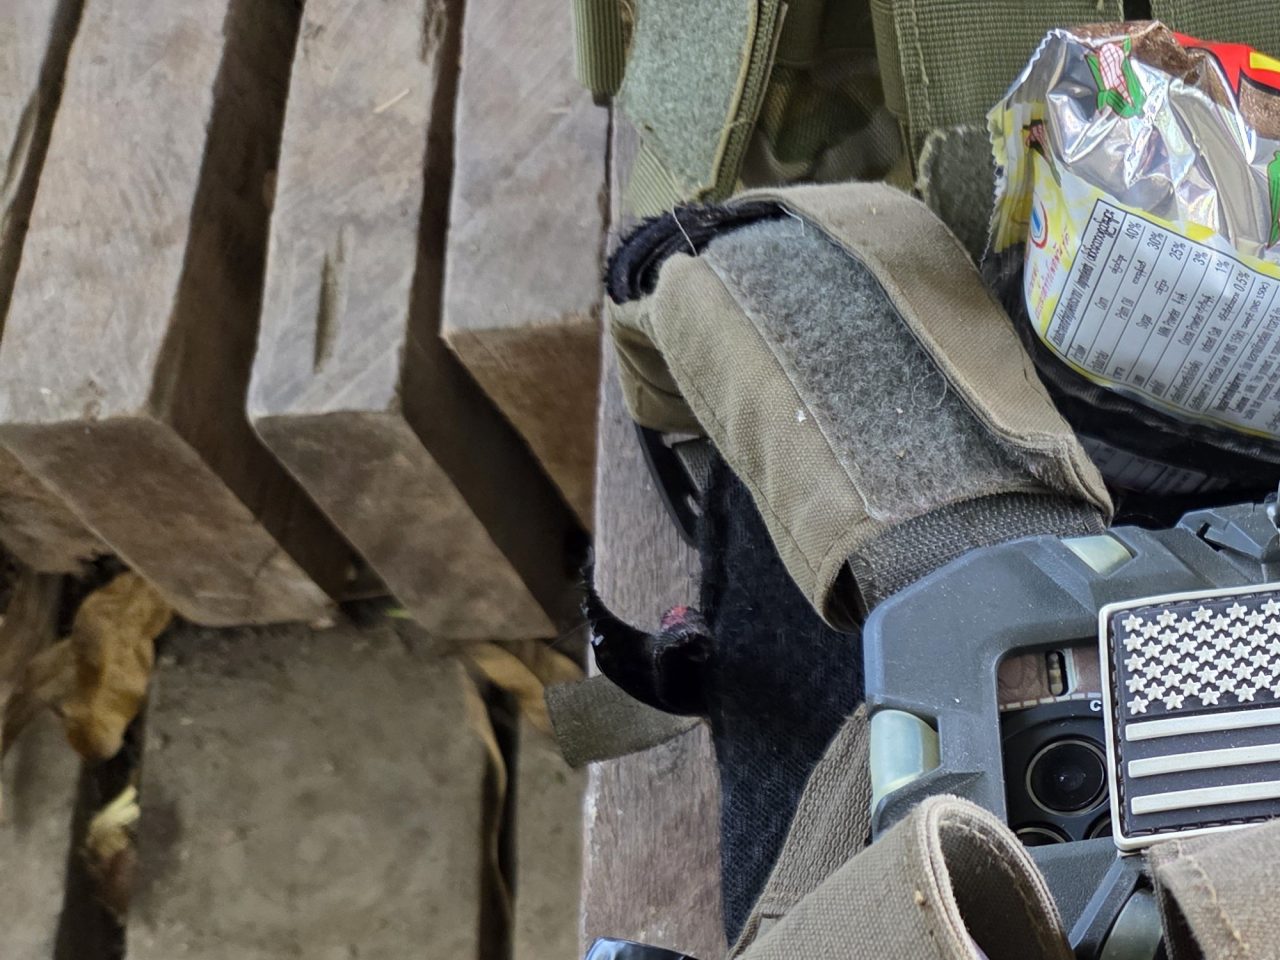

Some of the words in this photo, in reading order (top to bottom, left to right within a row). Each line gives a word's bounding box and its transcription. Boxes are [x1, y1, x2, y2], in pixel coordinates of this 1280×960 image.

[1124, 221, 1142, 240] 40%
[1146, 231, 1164, 250] 30%
[1168, 241, 1186, 261] 25%
[1192, 250, 1208, 266] 3%
[1214, 259, 1230, 273] 1%
[1233, 270, 1250, 292] 0.5%
[1114, 306, 1130, 320] Palm
[1162, 308, 1180, 327] Powder
[1135, 314, 1153, 329] Sugar
[1185, 312, 1204, 332] Powder
[1157, 326, 1171, 338] Milk
[1177, 330, 1195, 346] Cocoa
[1207, 326, 1223, 338] Salt
